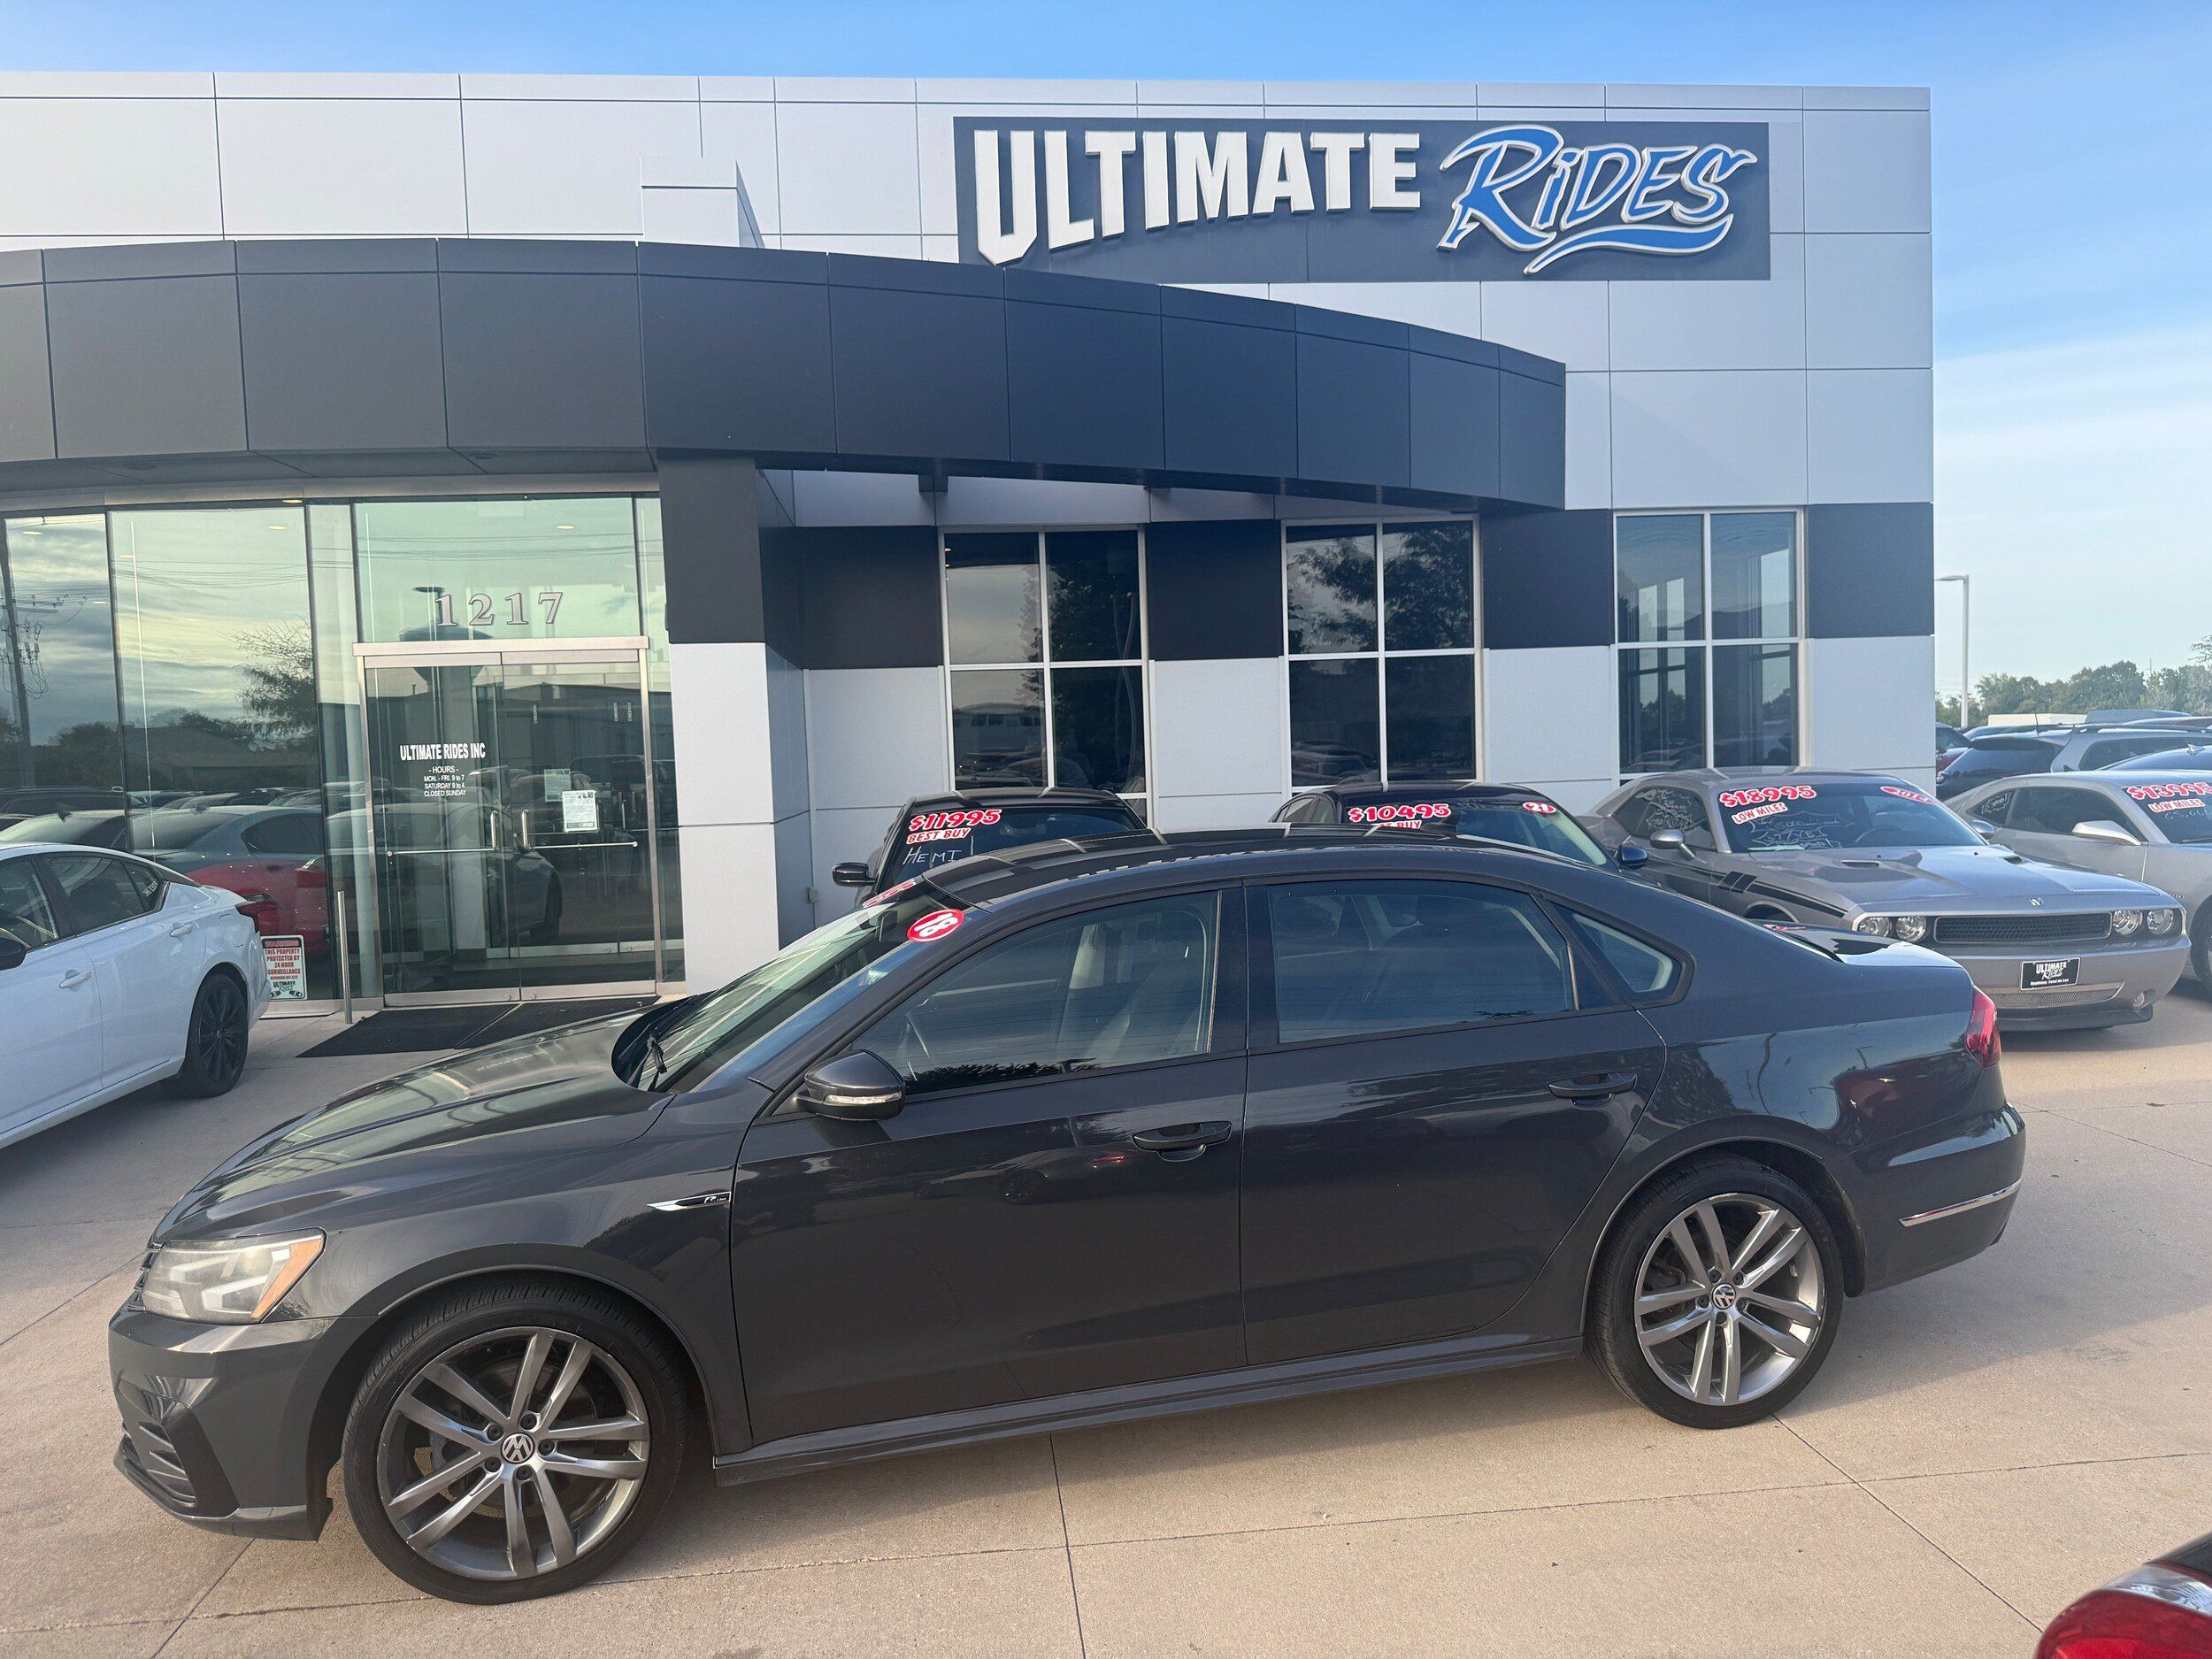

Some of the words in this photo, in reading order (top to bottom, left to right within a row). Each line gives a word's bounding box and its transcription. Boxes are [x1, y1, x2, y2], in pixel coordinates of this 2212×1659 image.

[973, 129, 1420, 265] ULTIMATE
[434, 591, 564, 627] 1217
[400, 743, 442, 761] ULTIMATE
[443, 743, 469, 759] RIDES
[470, 742, 486, 759] INC
[432, 765, 456, 774] HOURS
[1719, 785, 1817, 807] $18995
[2126, 782, 2212, 800] $13995
[1348, 803, 1452, 823] $10495
[1732, 809, 1755, 824] LOW
[1755, 803, 1787, 817] MILES
[2149, 802, 2173, 812] LOW
[2173, 799, 2203, 809] MILES
[908, 809, 1002, 832] $11995
[907, 832, 940, 844] BEST
[942, 827, 971, 839] BUY
[913, 912, 959, 938] 18
[2036, 961, 2067, 974] ULTIMATE
